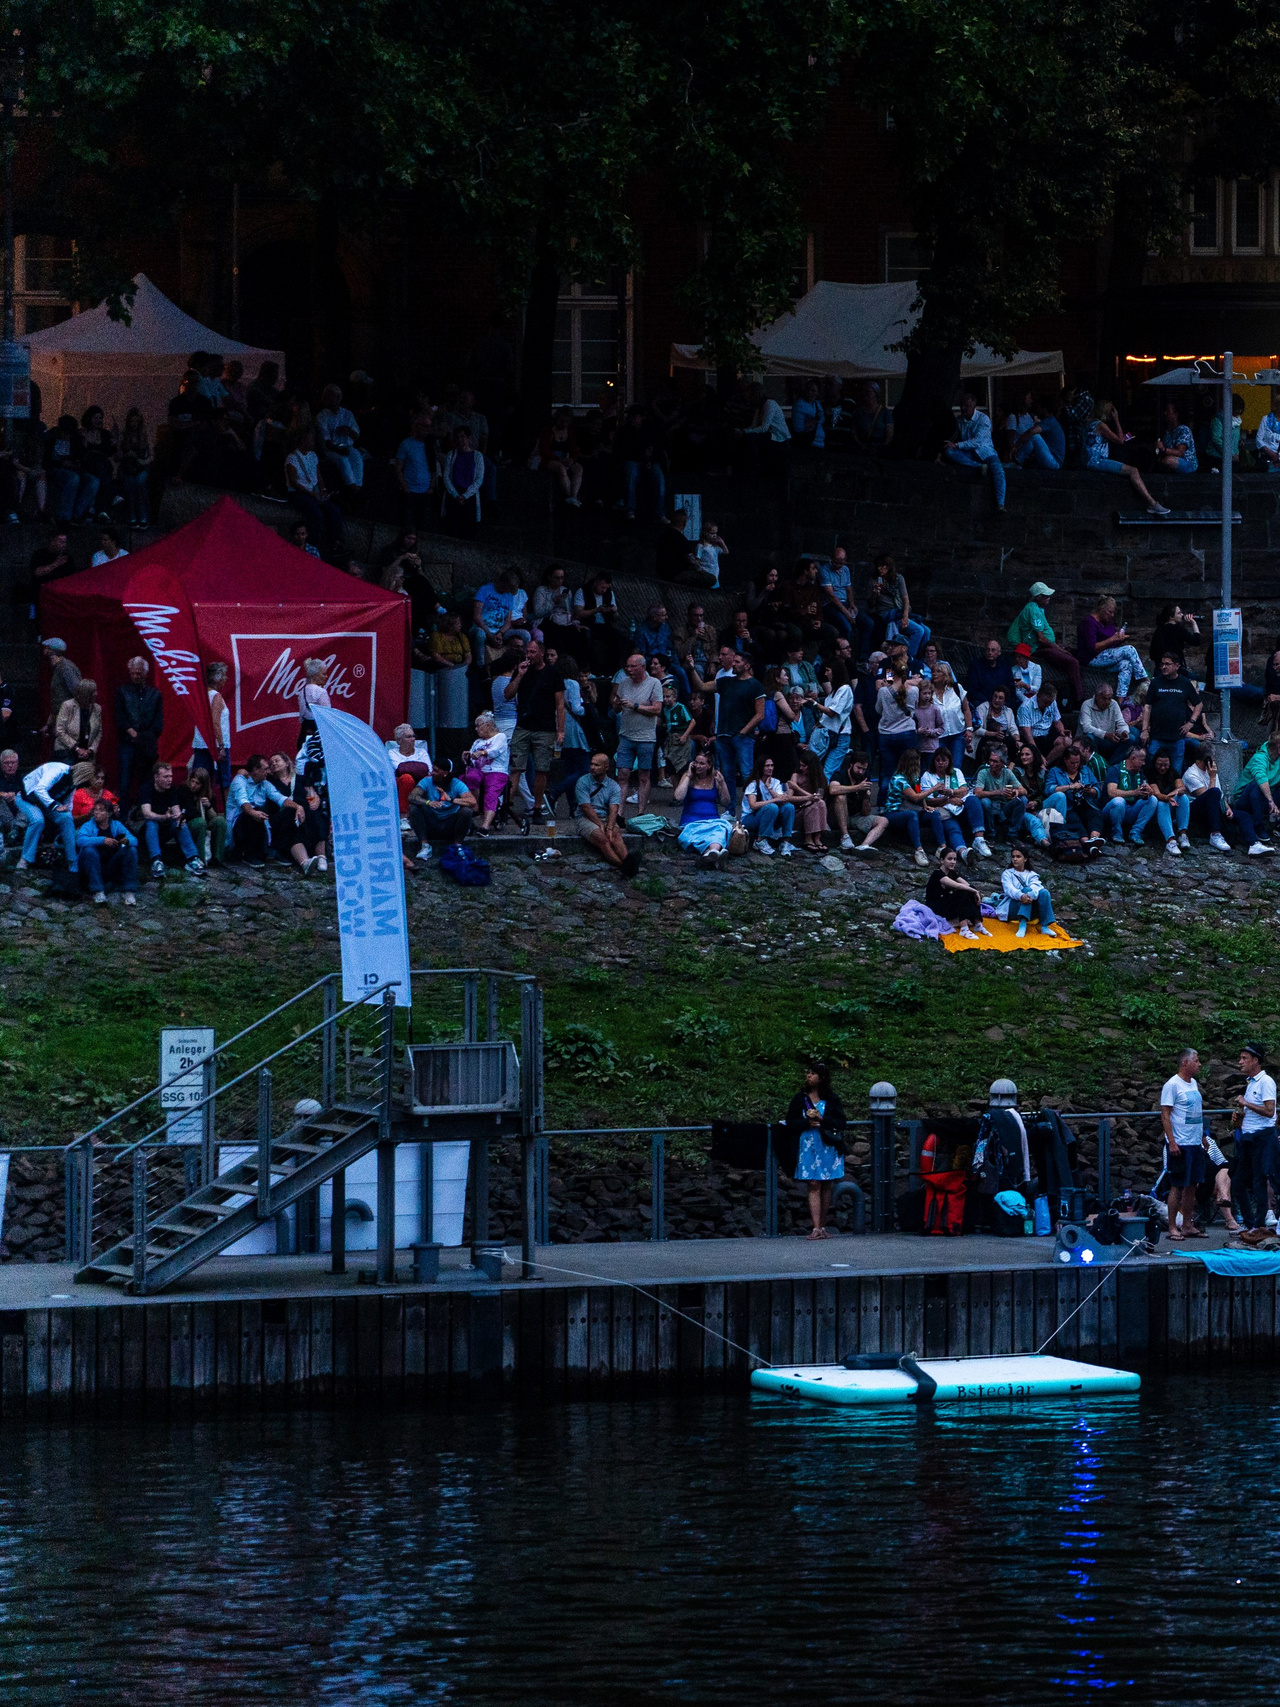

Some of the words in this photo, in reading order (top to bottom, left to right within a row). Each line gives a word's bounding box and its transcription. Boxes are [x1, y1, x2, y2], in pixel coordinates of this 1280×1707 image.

[122, 603, 200, 697] Melitta
[253, 647, 356, 701] Metta
[169, 1045, 206, 1056] Anleger
[180, 1057, 194, 1069] 2h
[162, 1092, 185, 1102] SSG
